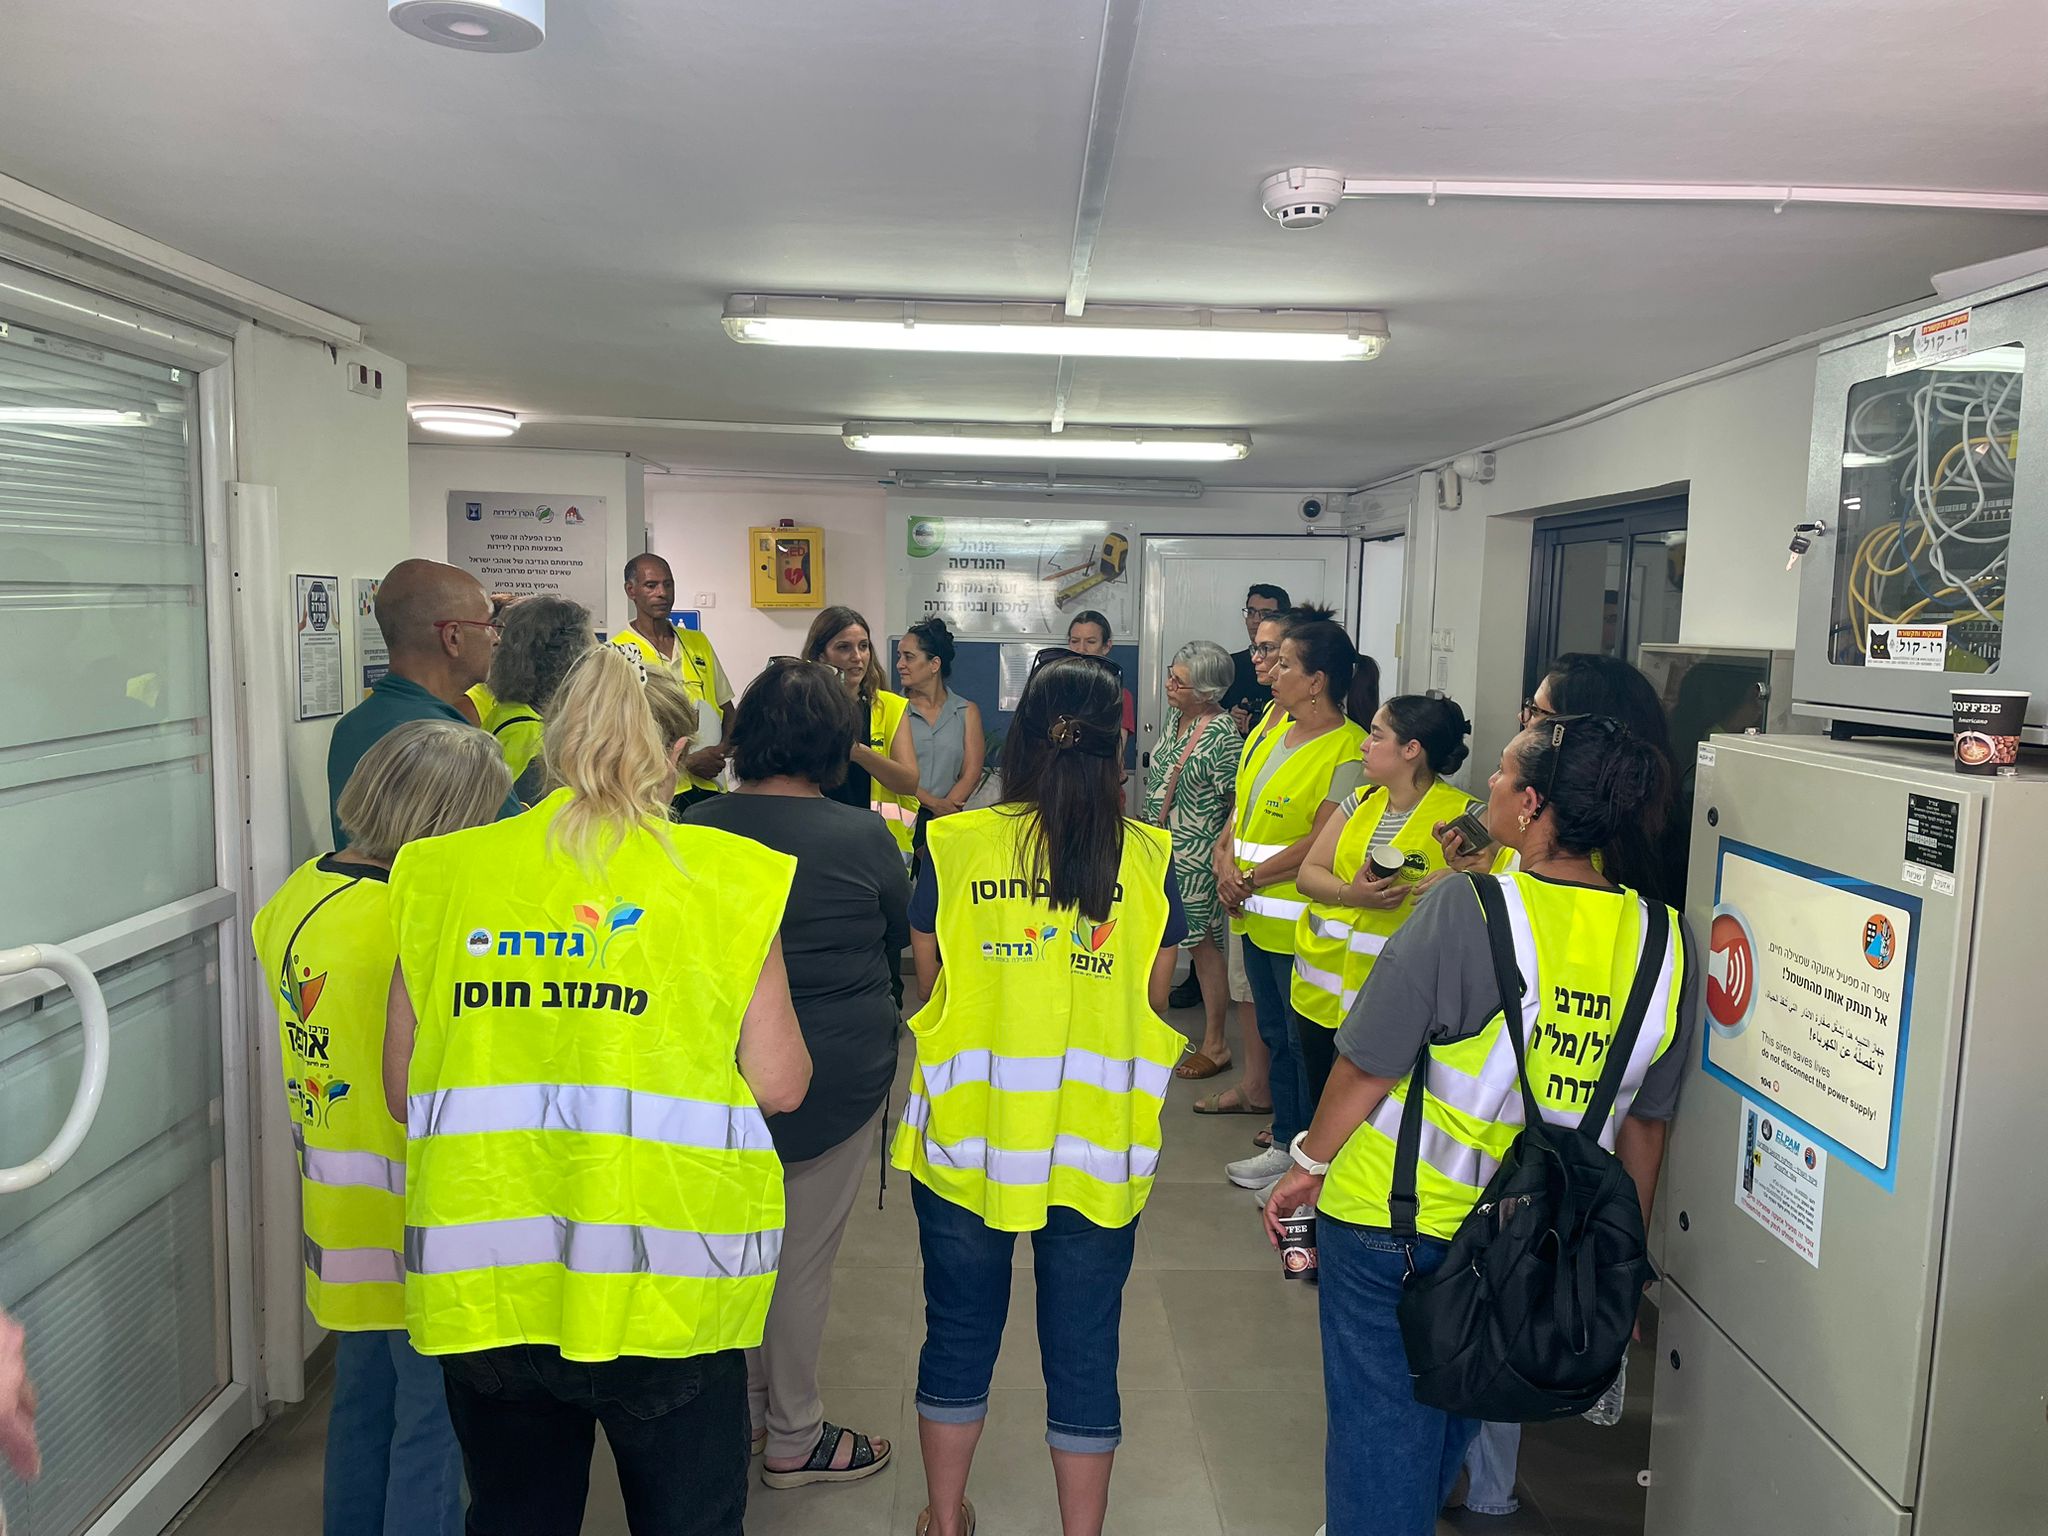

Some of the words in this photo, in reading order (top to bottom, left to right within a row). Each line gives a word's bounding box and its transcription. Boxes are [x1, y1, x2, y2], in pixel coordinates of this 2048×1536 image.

[959, 538, 996, 552] מנהל
[469, 555, 490, 563] ישראל
[949, 557, 1005, 569] ההנדסה
[533, 582, 559, 590] השיפוץ
[924, 600, 954, 611] גדרה
[957, 601, 987, 612] ובניה
[991, 600, 1030, 615] לתכנון
[1900, 639, 1943, 656] רז-קול
[1953, 702, 2002, 713] COFFEE
[971, 877, 1028, 904] חוסן
[498, 932, 584, 957] גדרה
[995, 943, 1033, 956] גדרה
[1784, 948, 1810, 968] שמצילה
[1811, 960, 1835, 979] אזעקה
[1835, 968, 1860, 989] מפעיל
[1782, 967, 1822, 996] מהחשמל!
[1860, 981, 1870, 994] זה
[453, 981, 531, 1017] חוסן
[1554, 986, 1611, 1020] תנדבי
[1824, 988, 1844, 1006] אותו
[1871, 985, 1890, 1003] צופר
[1845, 997, 1872, 1019] תנתק
[1874, 1007, 1888, 1026] אל
[308, 1025, 329, 1035] מרכז
[1761, 1031, 1774, 1047] This
[1775, 1041, 1791, 1056] siren
[1792, 1051, 1812, 1068] saves
[1814, 1060, 1831, 1078] lives
[1761, 1048, 1769, 1058] do
[1770, 1053, 1780, 1066] not
[1780, 1059, 1815, 1085] disconnect
[1815, 1079, 1827, 1092] the
[1827, 1087, 1849, 1105] power
[1850, 1099, 1877, 1121] supply!
[1776, 1129, 1801, 1152] ELPAM
